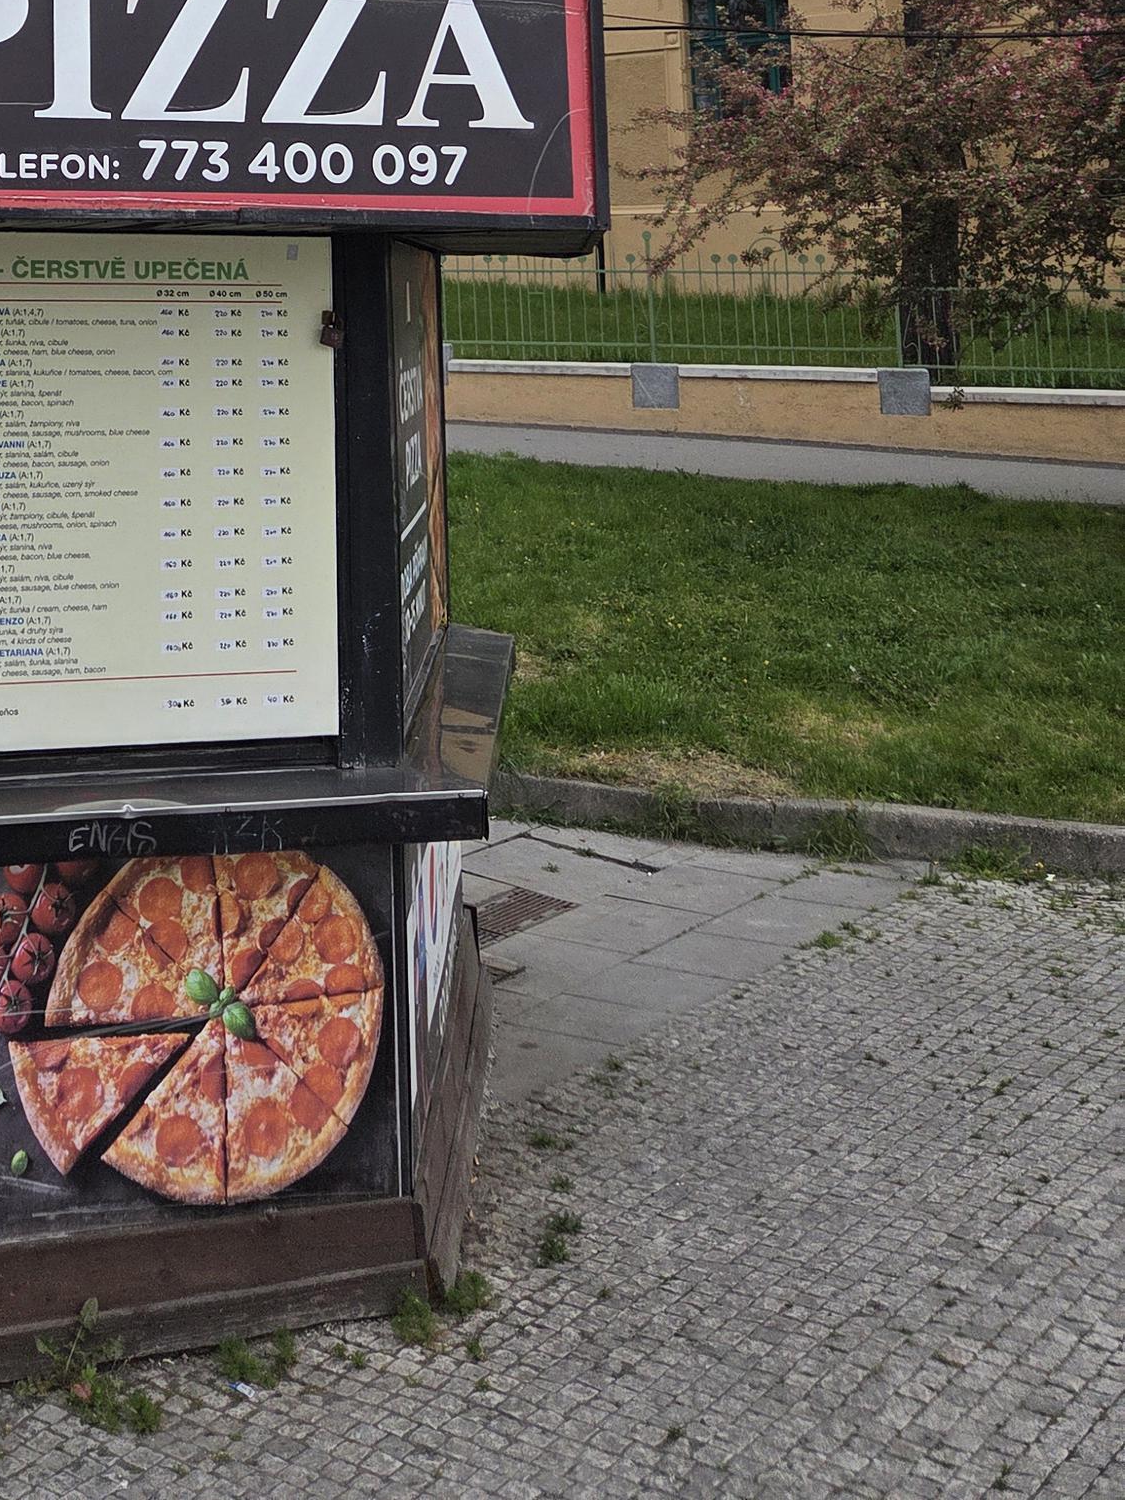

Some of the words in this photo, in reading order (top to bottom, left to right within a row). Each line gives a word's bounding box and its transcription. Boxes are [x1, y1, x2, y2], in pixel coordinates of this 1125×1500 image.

[139, 140, 229, 181] 773
[248, 142, 353, 183] 400
[373, 145, 467, 185] 097
[12, 255, 125, 279] ČERSTVĚ
[134, 258, 249, 280] UPEČENÁ
[12, 308, 44, 318] (A:1,4,7)
[46, 647, 71, 657] (A:1,7)
